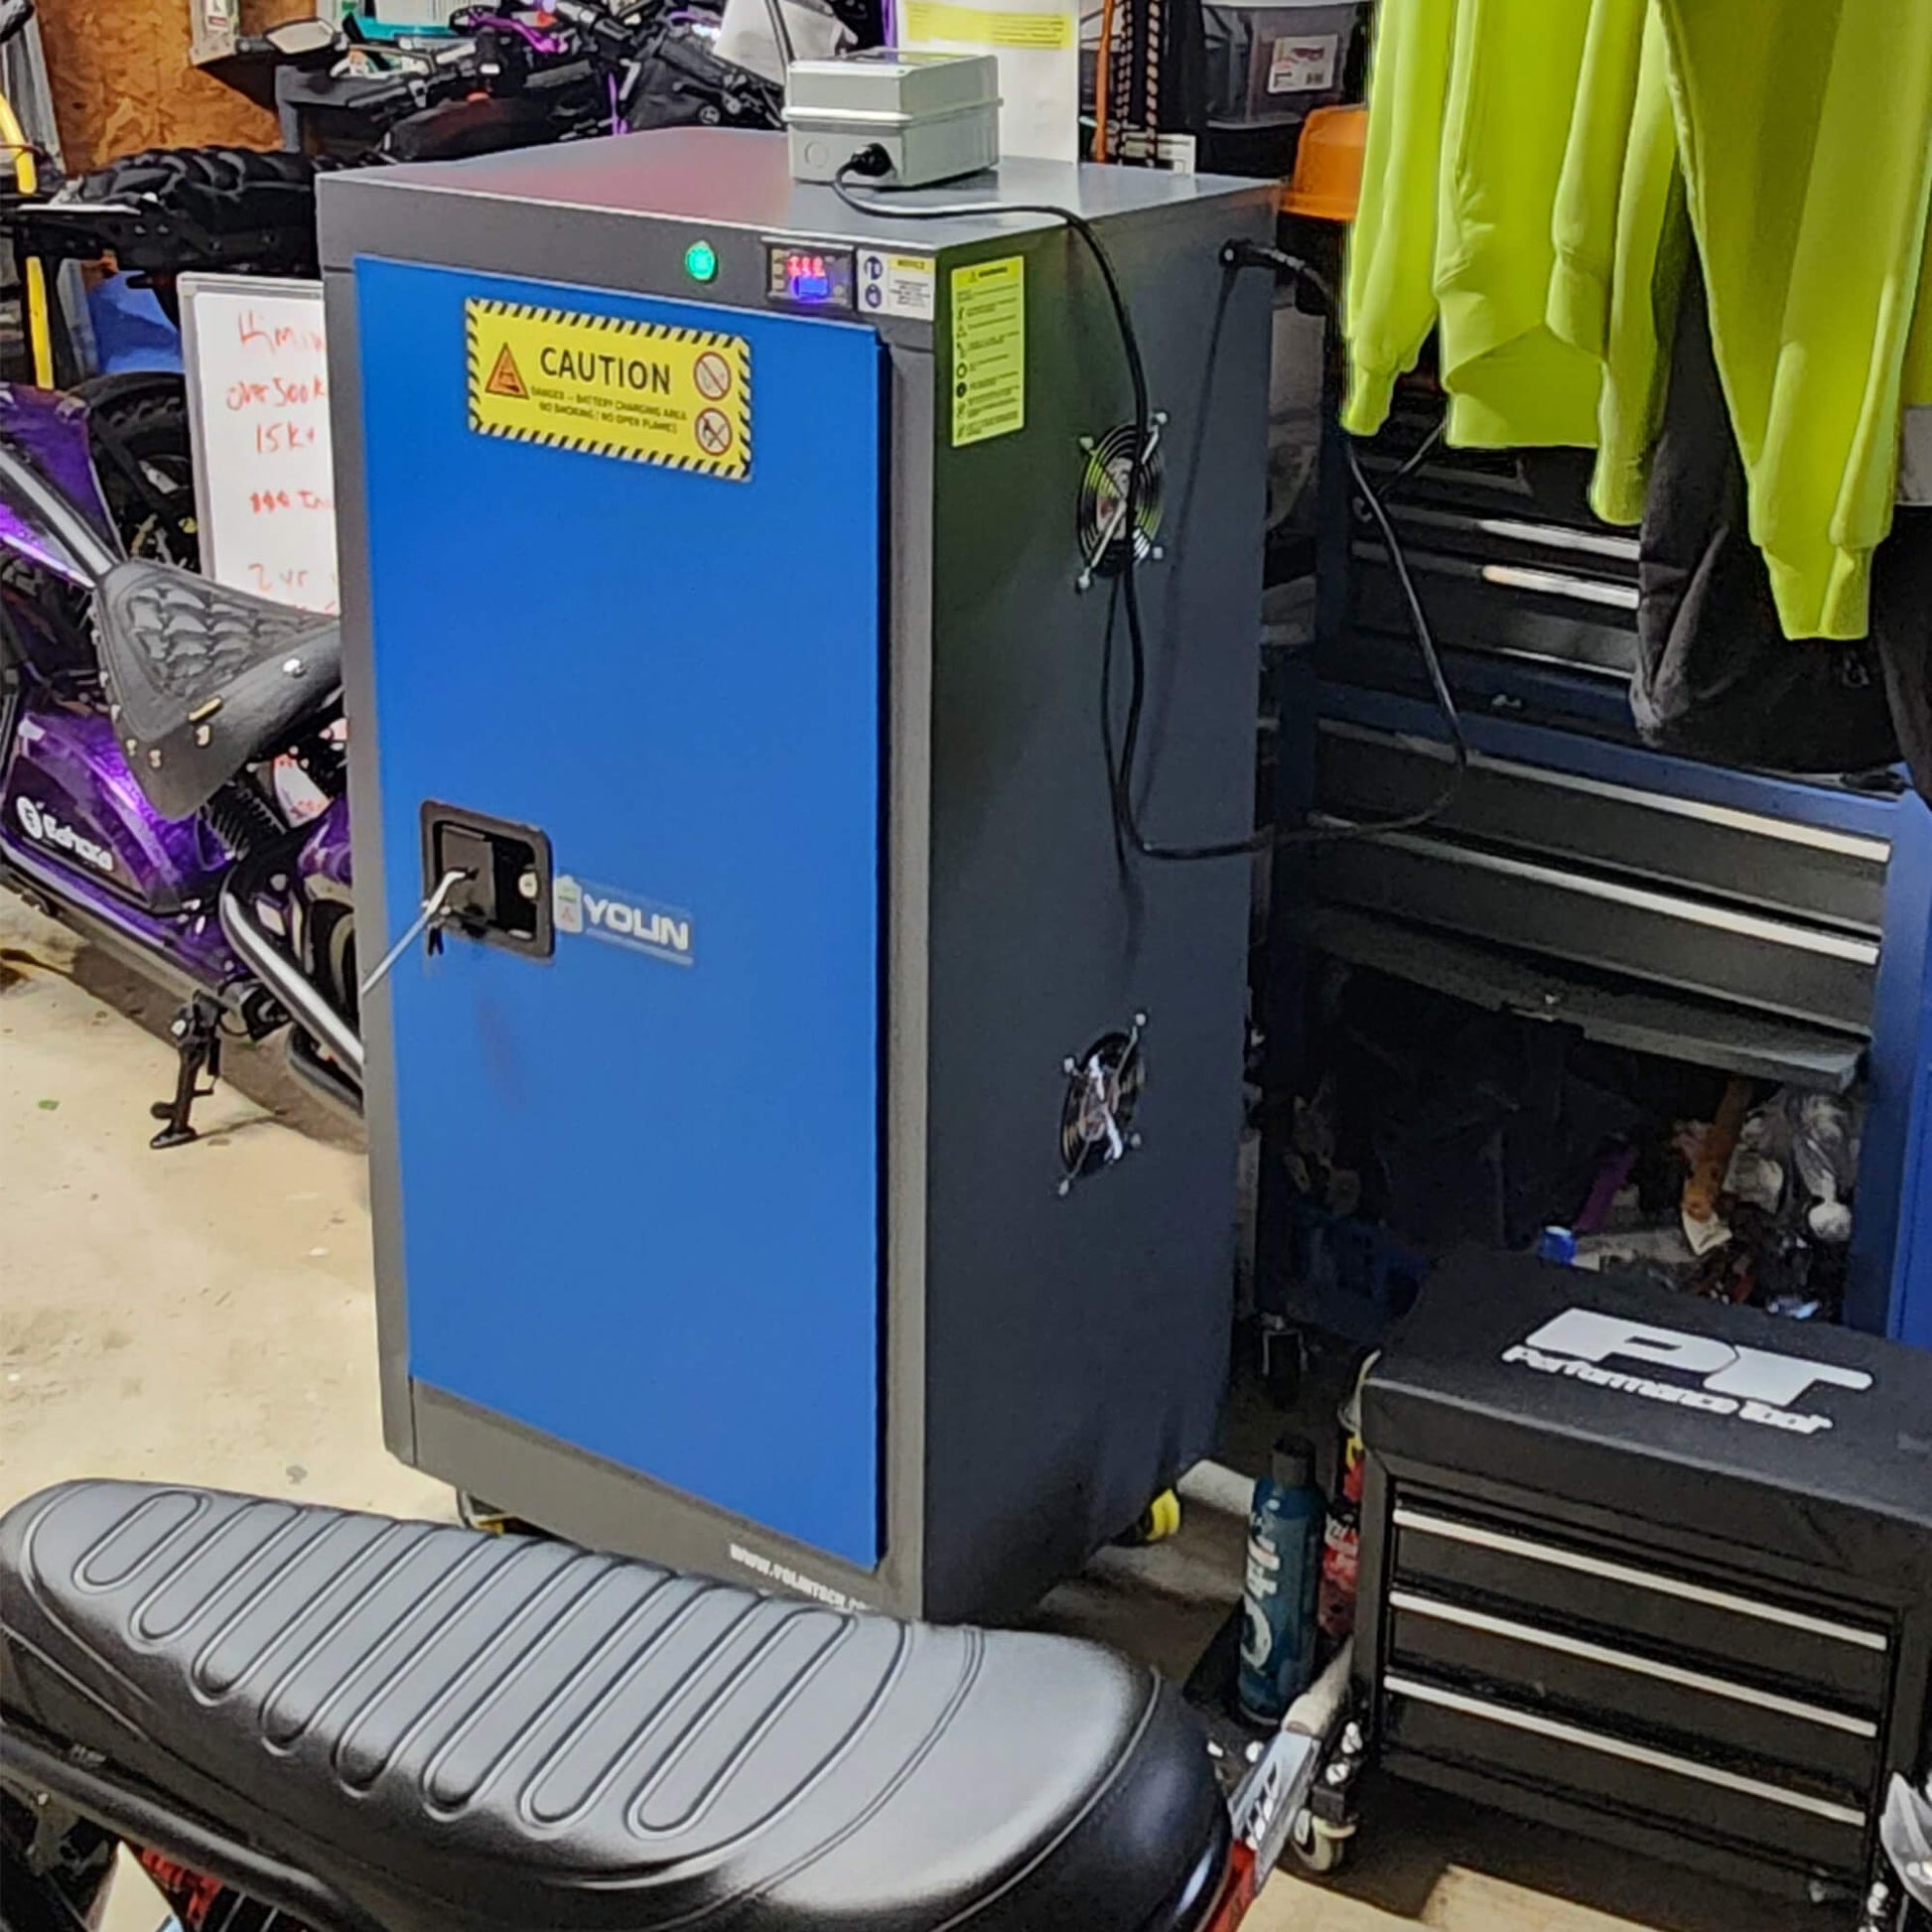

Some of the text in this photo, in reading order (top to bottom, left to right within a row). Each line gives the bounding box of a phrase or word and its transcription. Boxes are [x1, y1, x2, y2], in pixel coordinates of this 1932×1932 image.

[540, 346, 670, 395] CAUTION
[1501, 1345, 1739, 1414] Performance
[1526, 1308, 1872, 1407] PT
